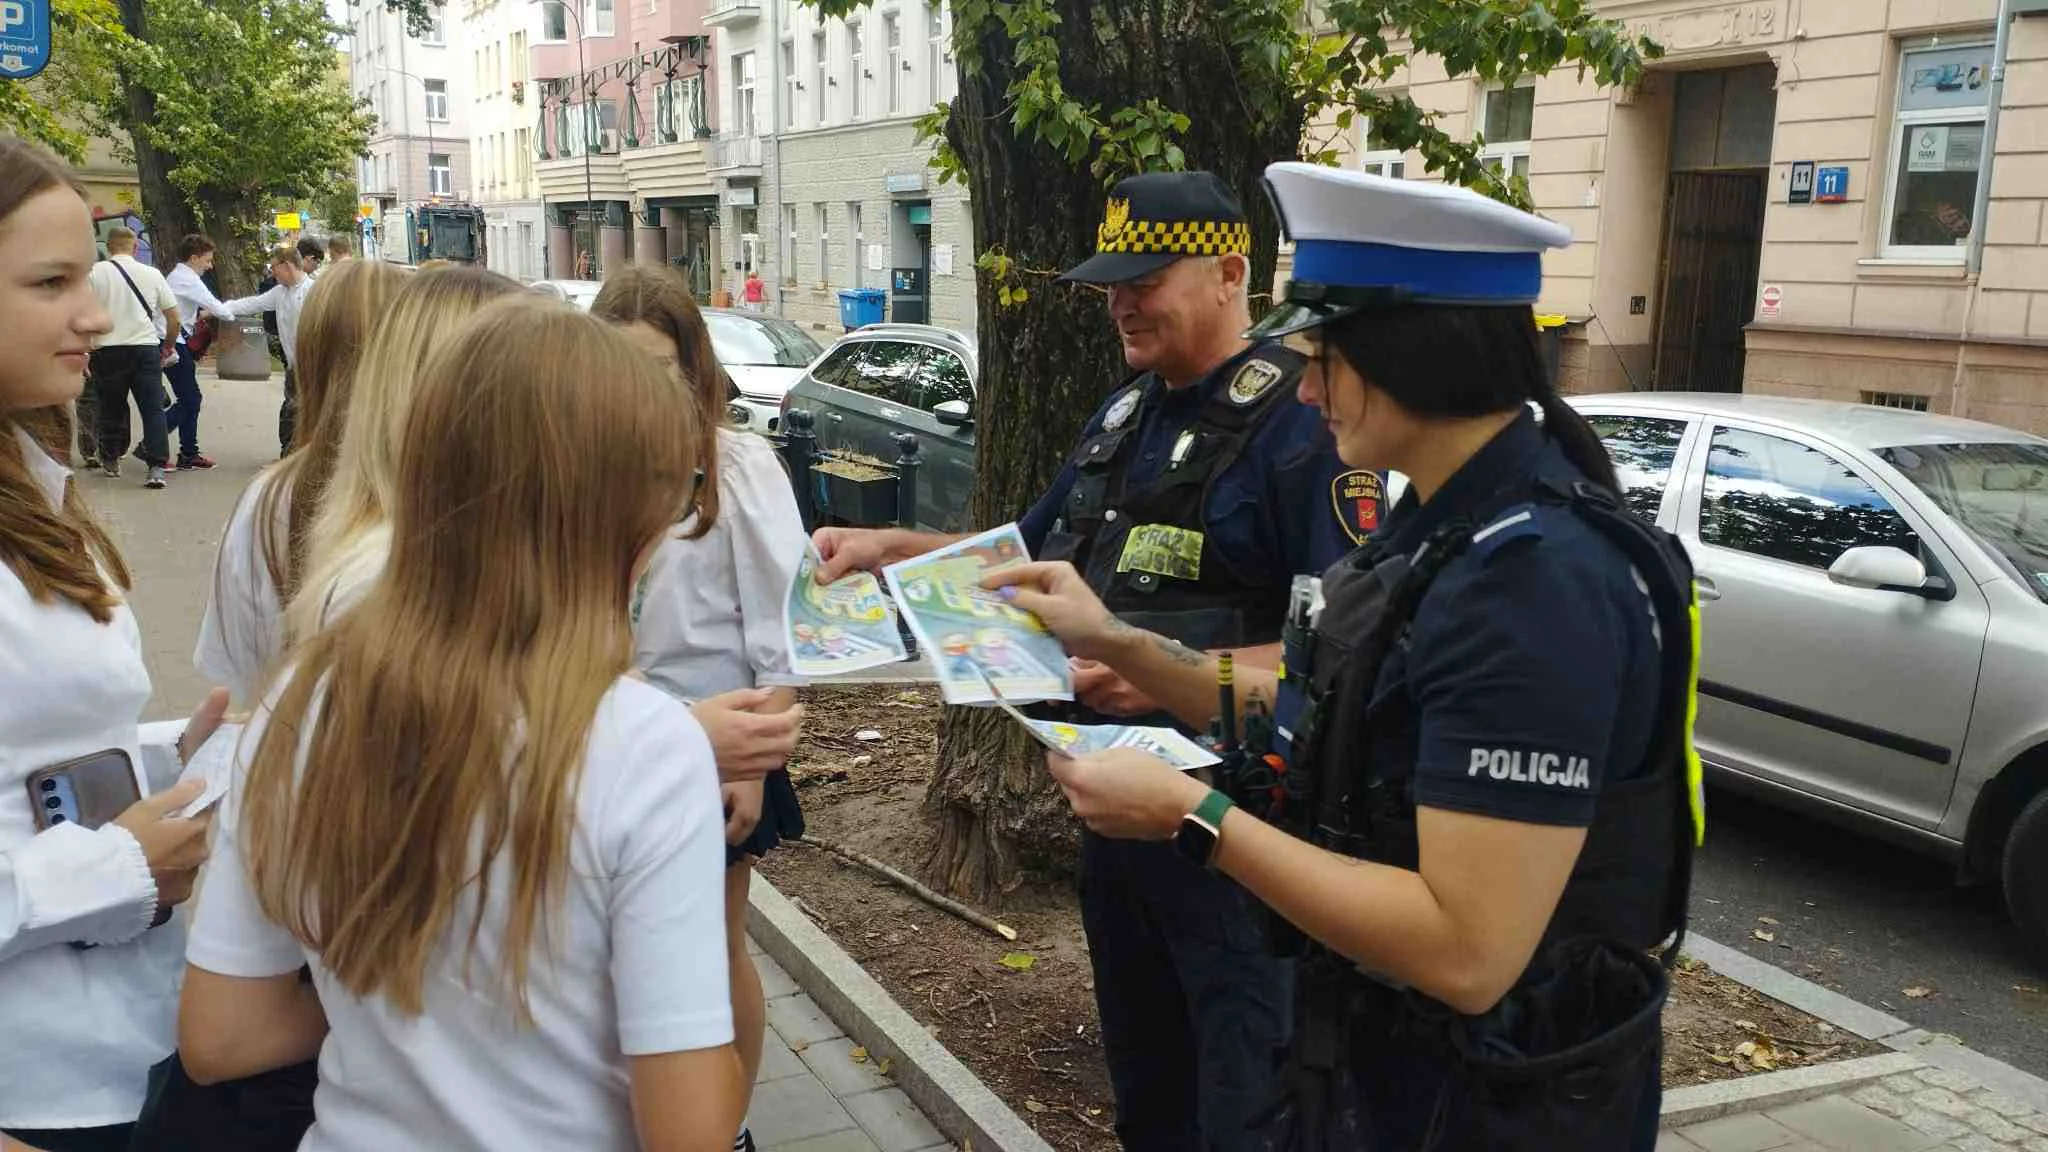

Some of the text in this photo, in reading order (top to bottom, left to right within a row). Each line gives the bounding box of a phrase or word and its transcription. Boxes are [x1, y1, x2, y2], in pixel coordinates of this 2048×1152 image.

[0, 1, 24, 32] P
[1825, 175, 1838, 193] 11
[1468, 748, 1590, 789] POLICJA
